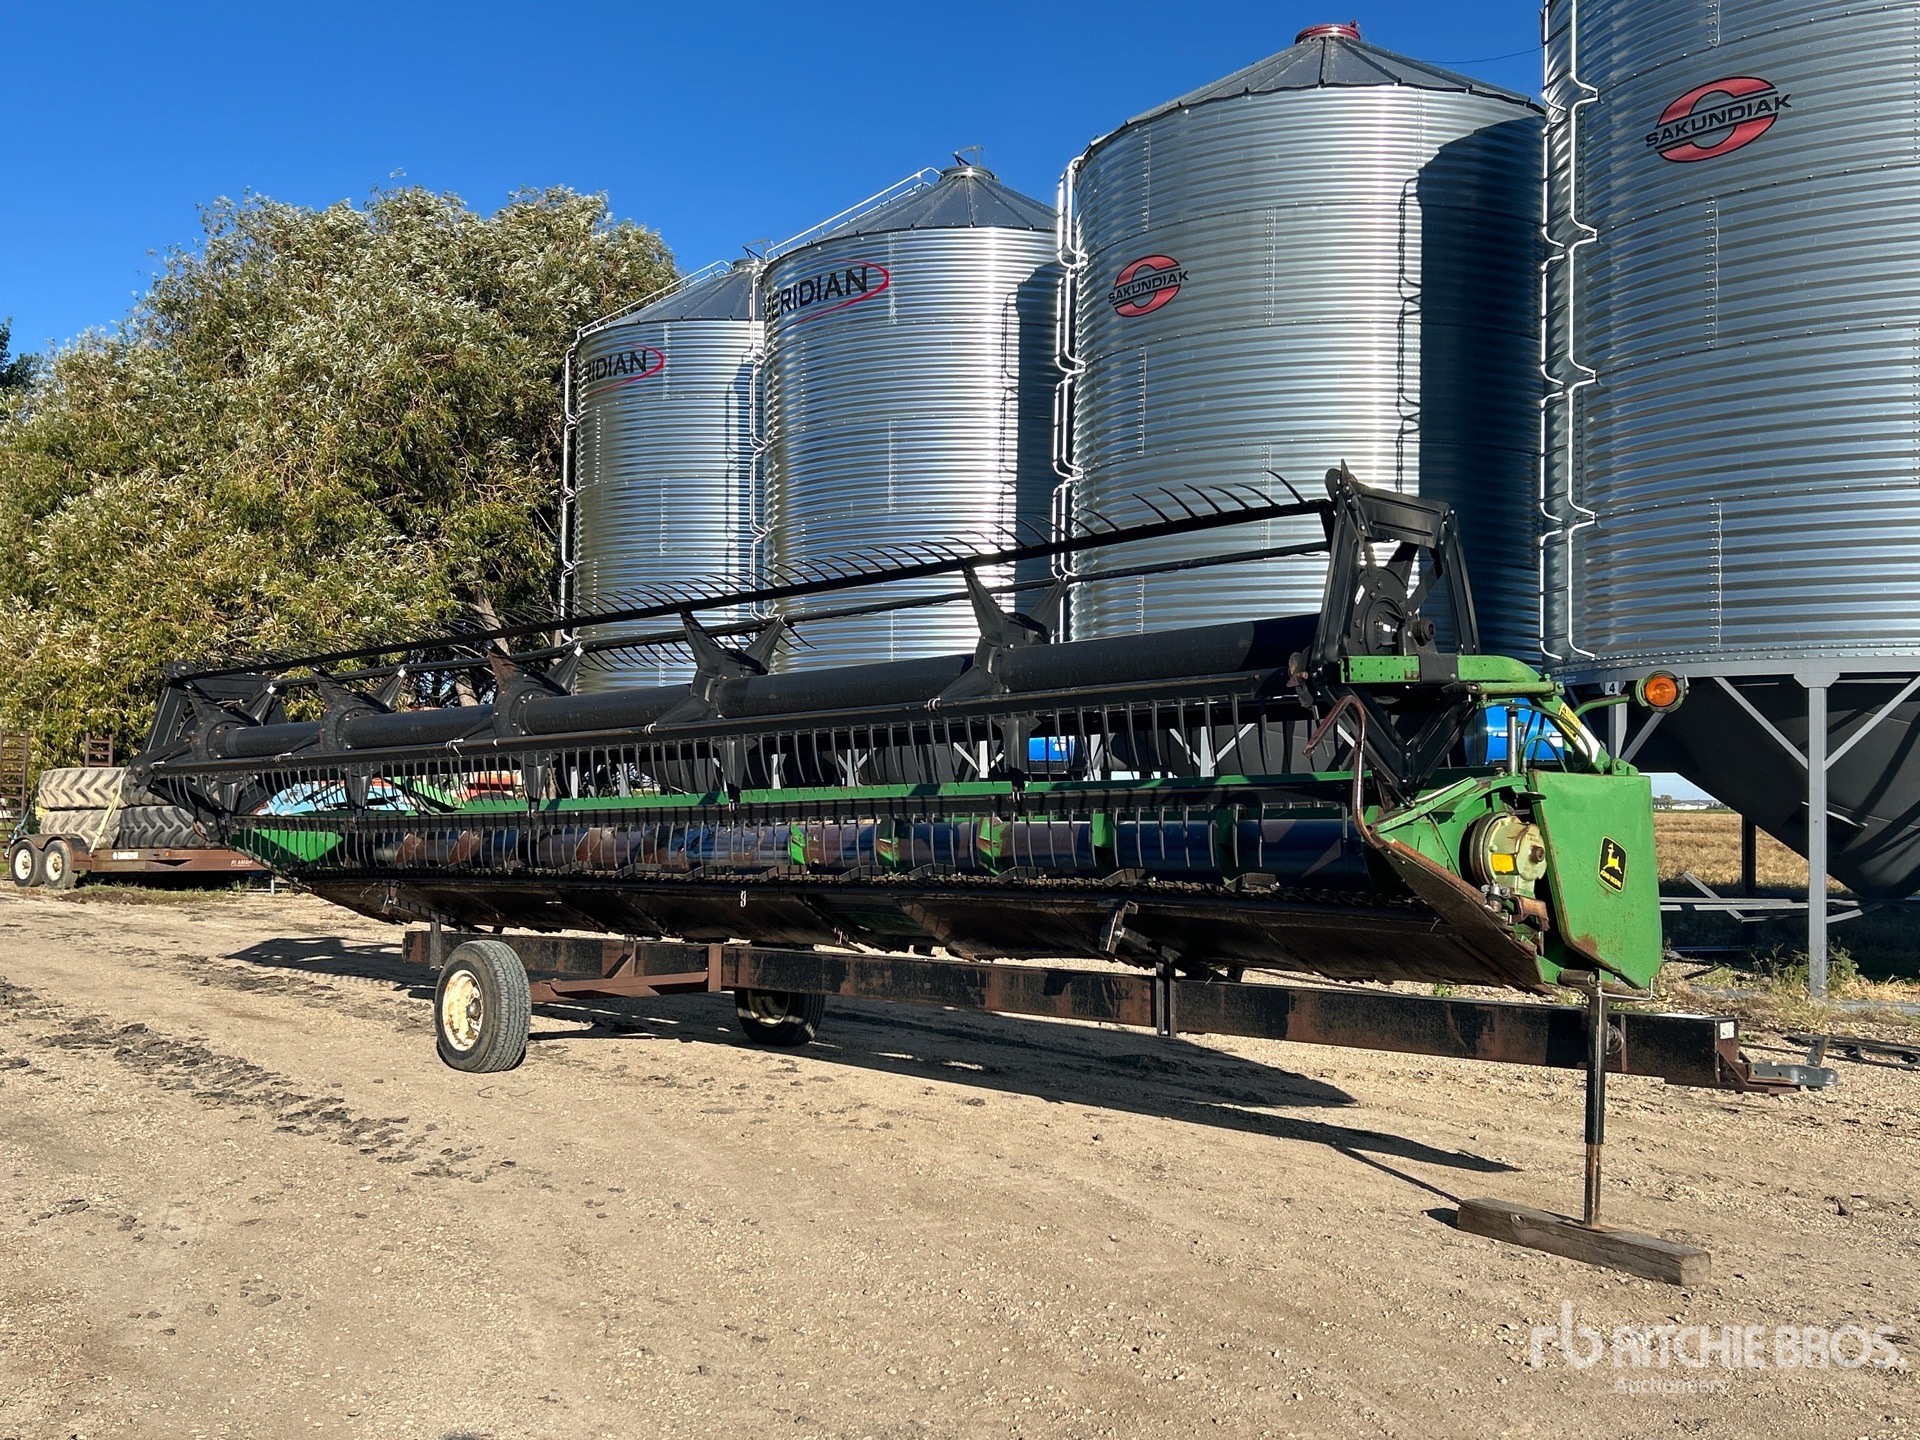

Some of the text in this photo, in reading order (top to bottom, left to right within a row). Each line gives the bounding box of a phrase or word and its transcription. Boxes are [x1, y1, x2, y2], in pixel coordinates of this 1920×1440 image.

[1645, 93, 1793, 148] SAKUNDIAK
[1108, 270, 1190, 304] SAKUNDIAK
[1608, 682, 1616, 694] 4
